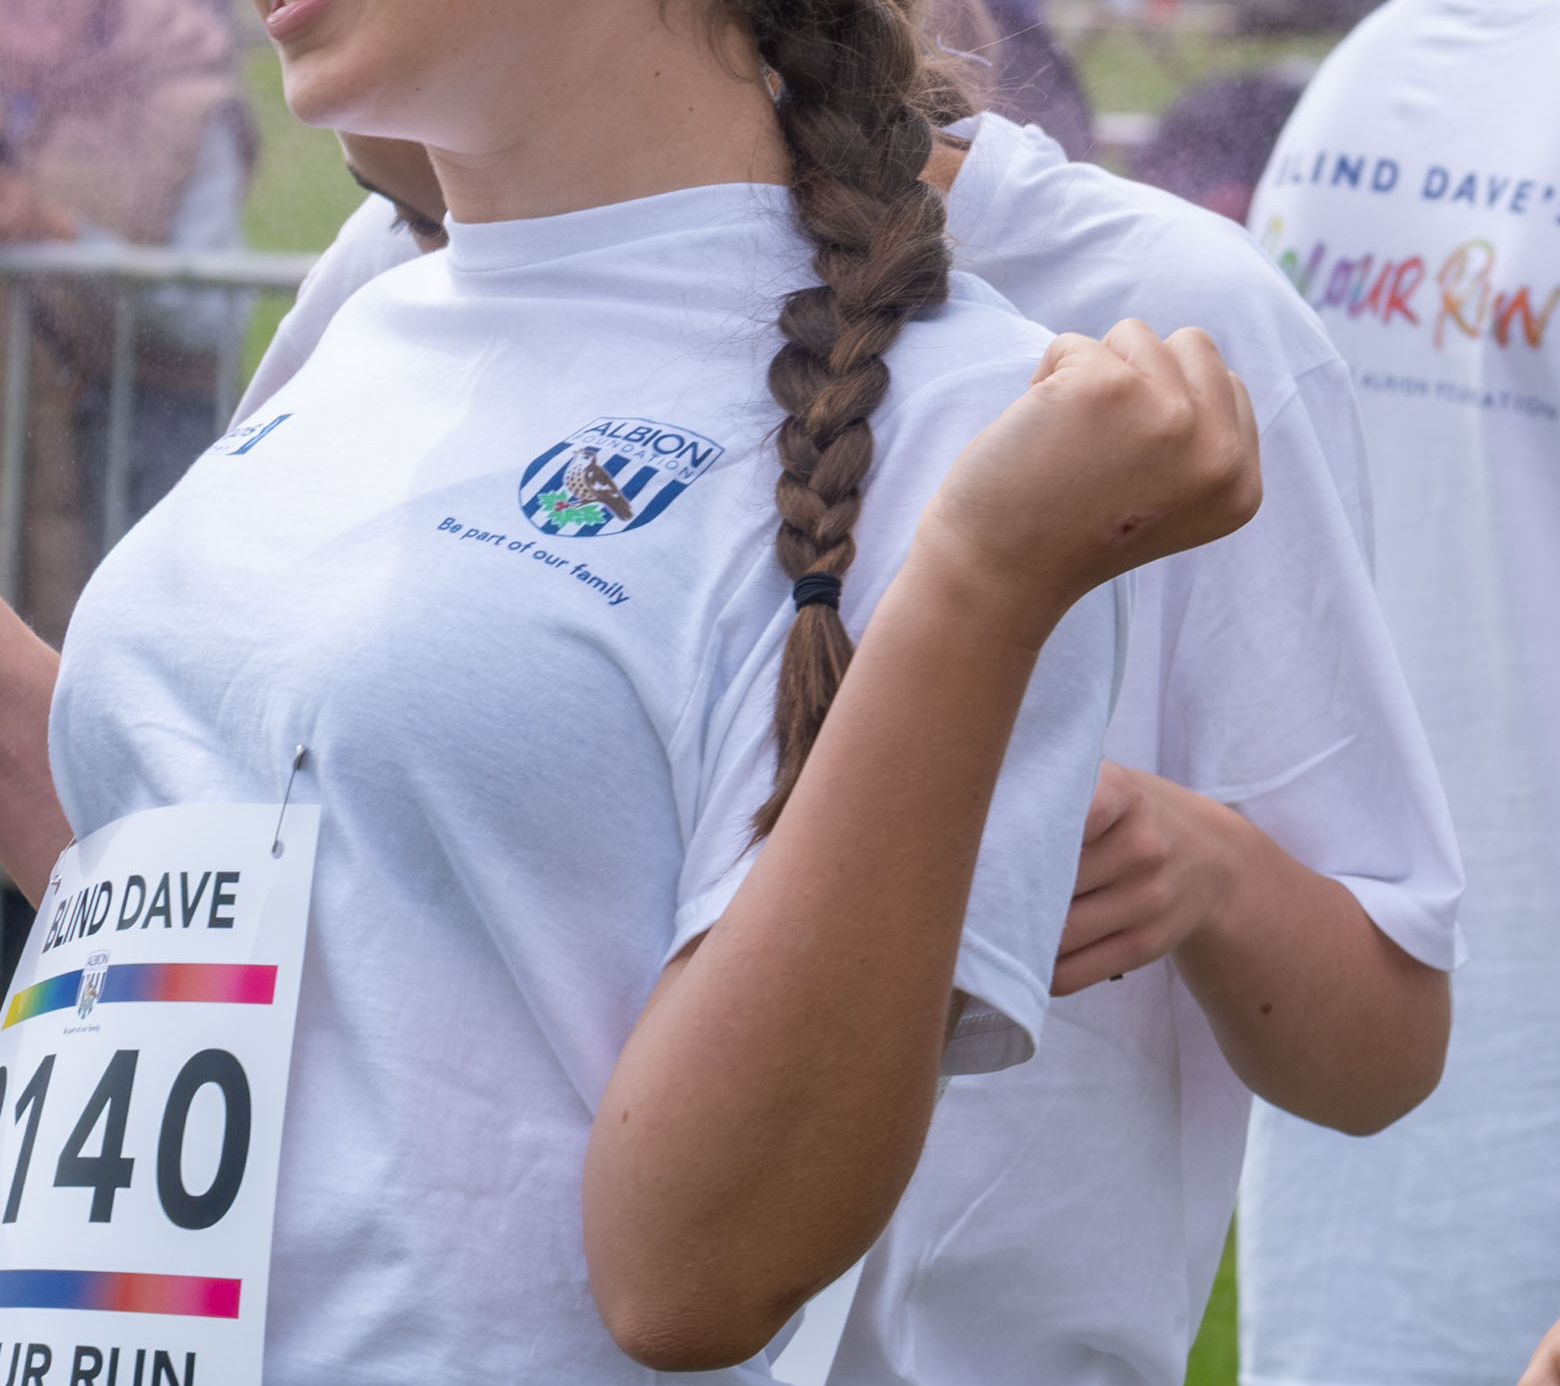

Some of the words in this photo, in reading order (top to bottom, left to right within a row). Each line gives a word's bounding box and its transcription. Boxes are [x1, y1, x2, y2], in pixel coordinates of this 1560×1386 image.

[573, 435, 694, 479] FOUNDATION
[593, 421, 712, 468] ALBION
[437, 517, 461, 533] Be
[461, 526, 507, 546] part
[507, 542, 535, 554] of
[533, 549, 569, 569] our
[570, 564, 630, 606] family
[42, 881, 113, 954] BLIND
[116, 871, 240, 931] DAVE
